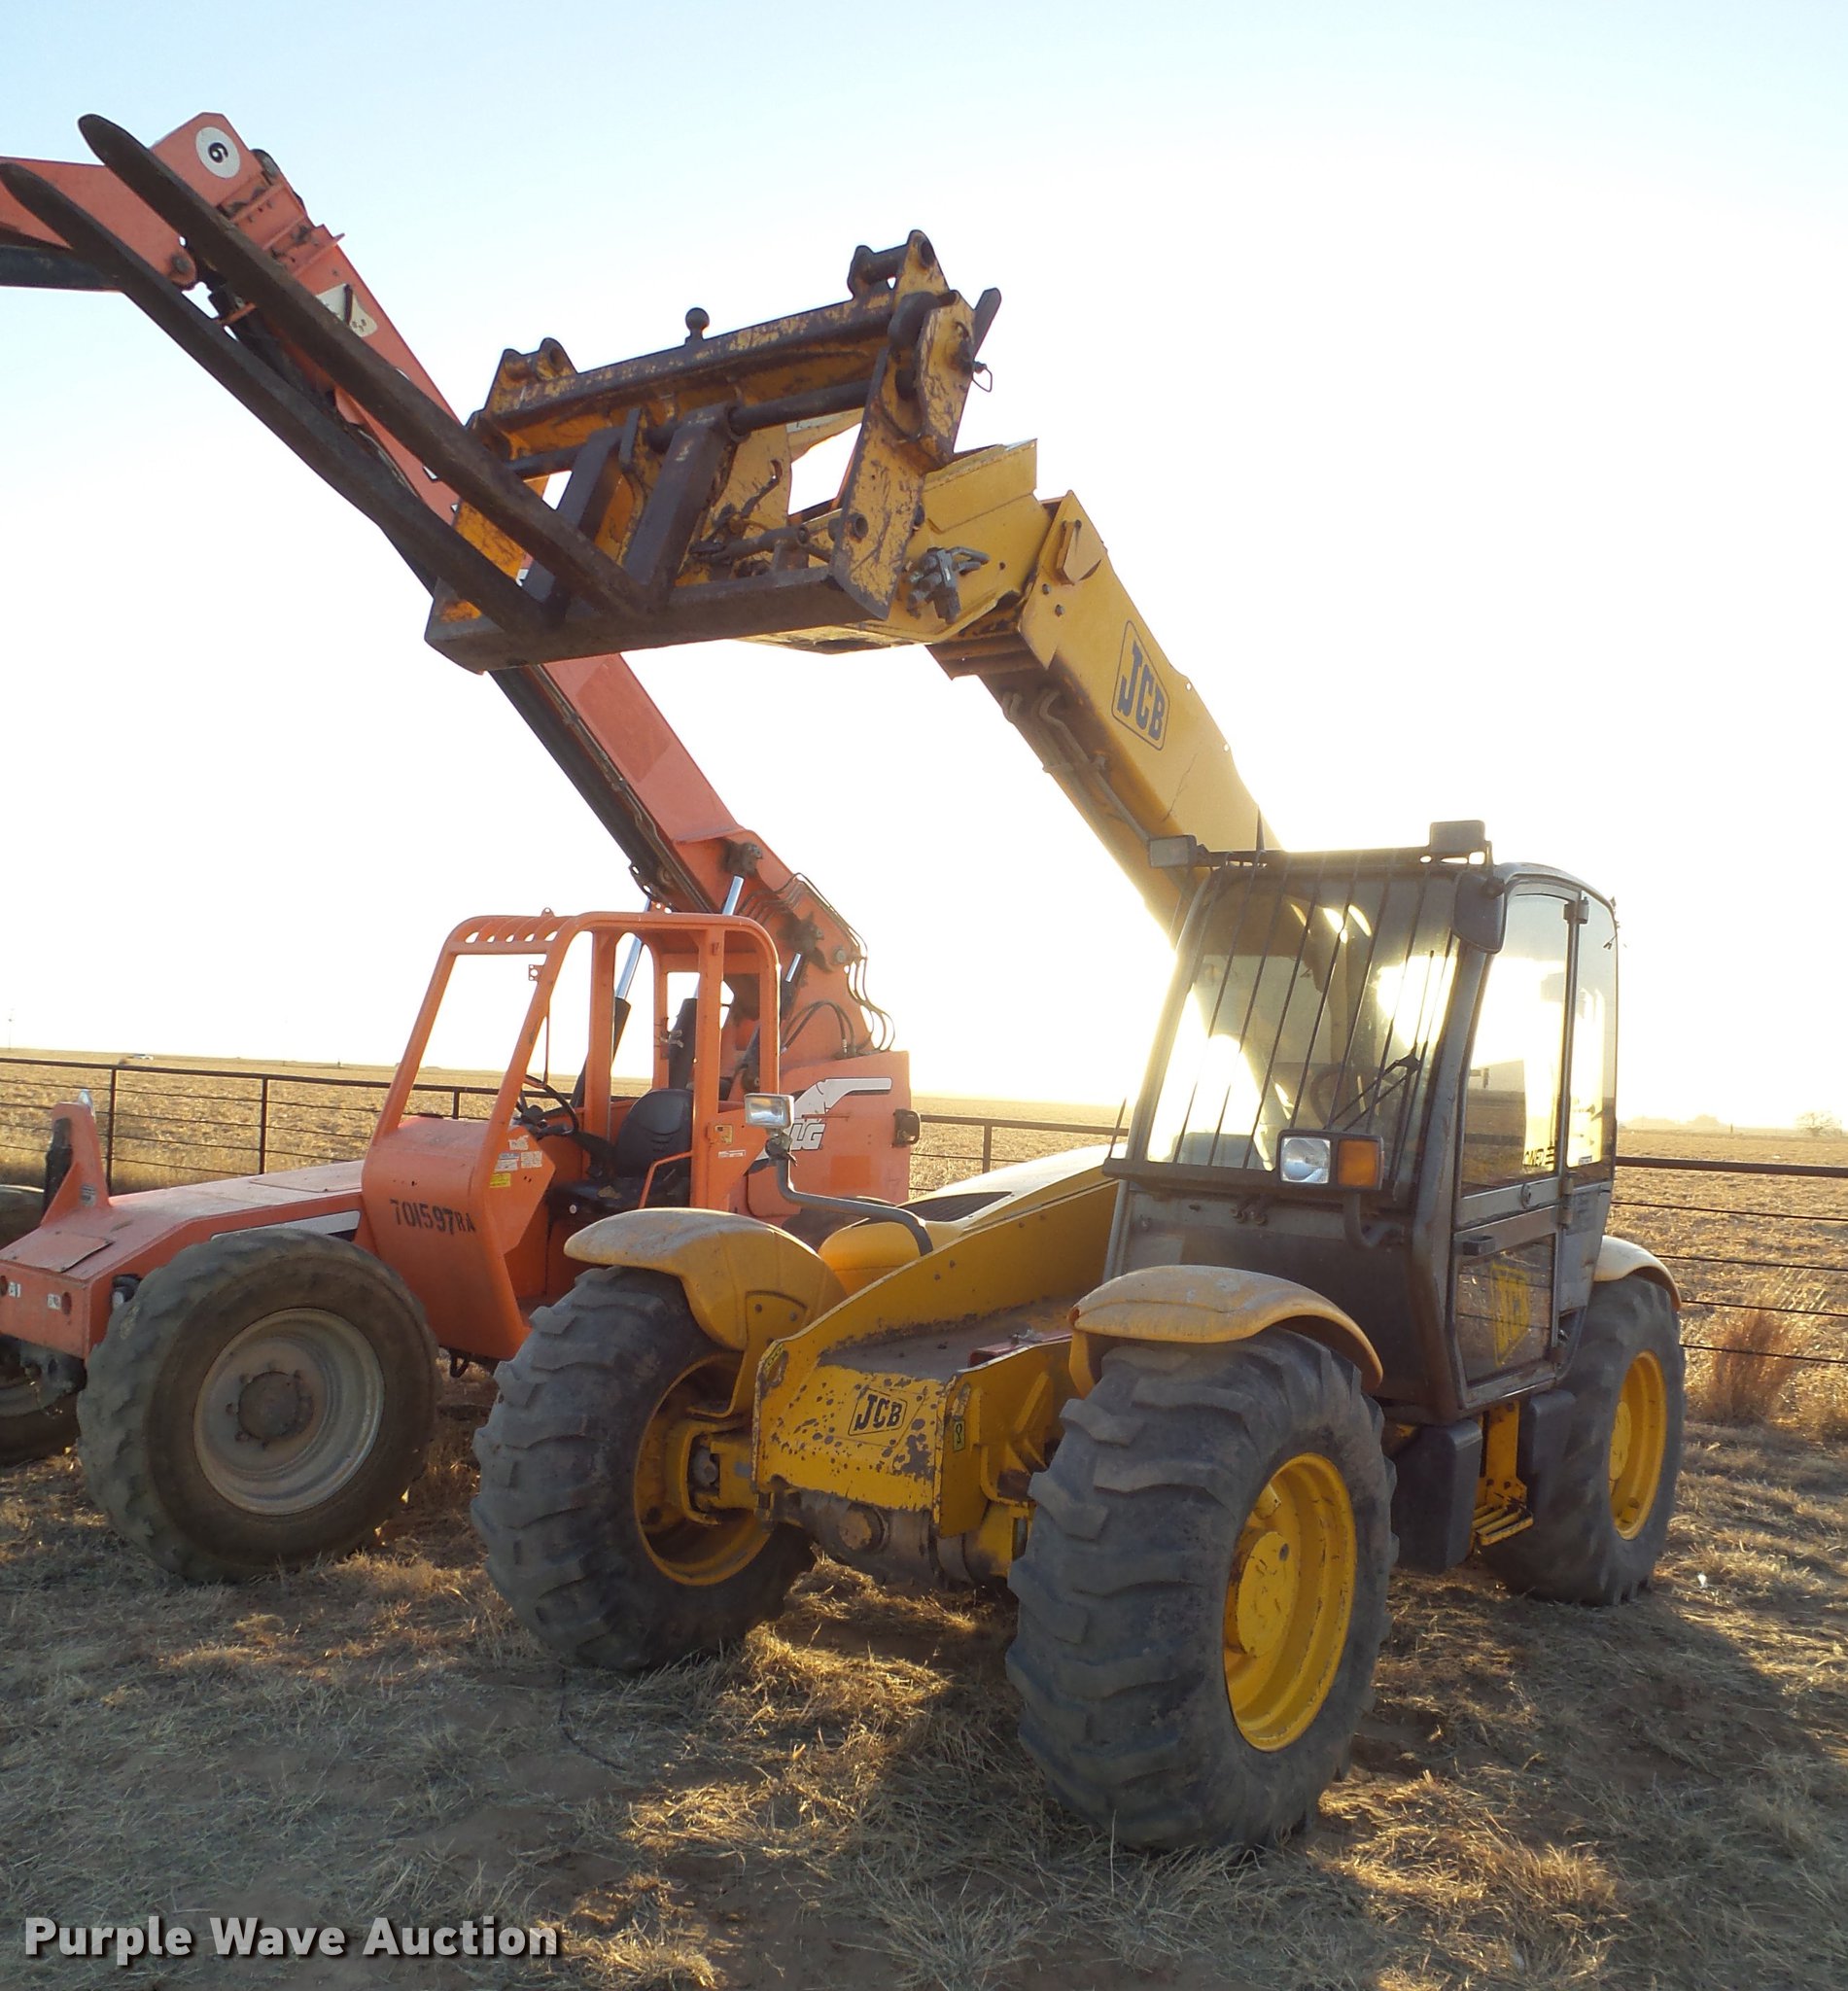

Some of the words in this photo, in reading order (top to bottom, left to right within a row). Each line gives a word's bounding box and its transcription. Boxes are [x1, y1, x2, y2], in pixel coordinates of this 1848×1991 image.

[207, 141, 229, 164] 6
[1116, 640, 1166, 742] JCB
[784, 1122, 826, 1151] LG
[389, 1198, 476, 1235] 701597RA
[853, 1393, 904, 1432] JCB
